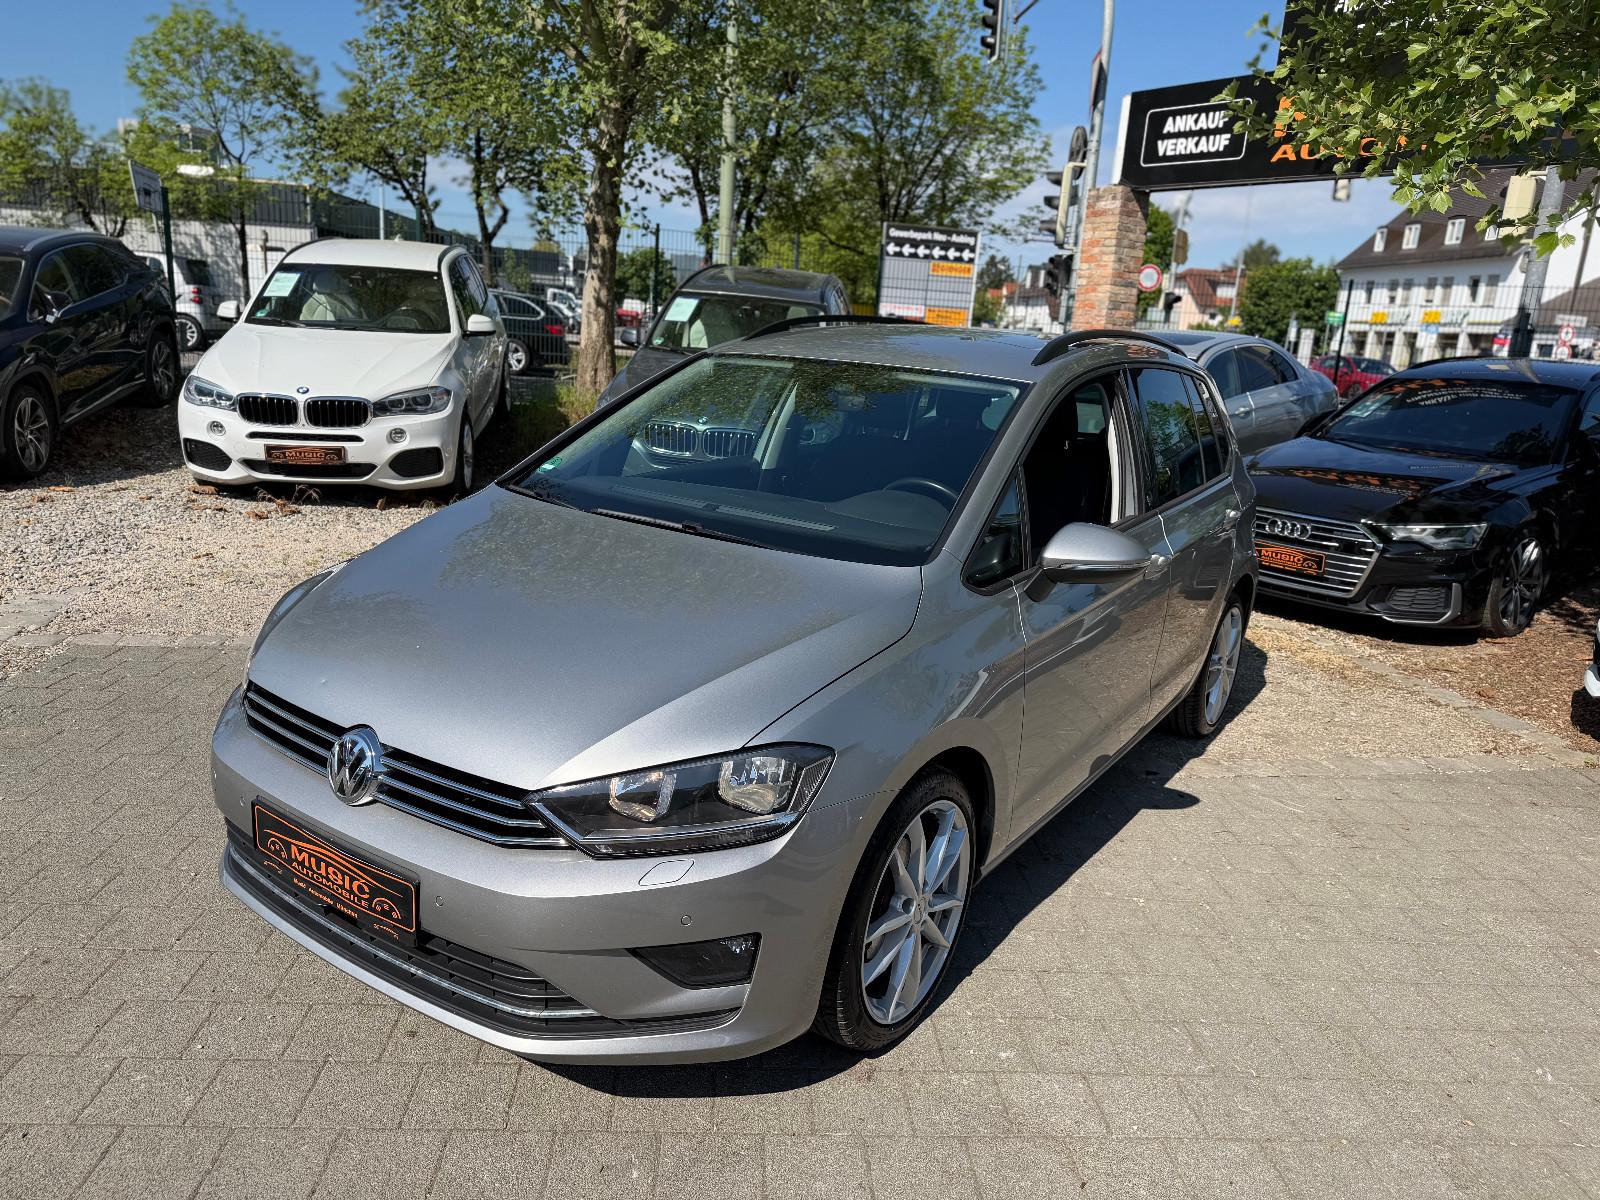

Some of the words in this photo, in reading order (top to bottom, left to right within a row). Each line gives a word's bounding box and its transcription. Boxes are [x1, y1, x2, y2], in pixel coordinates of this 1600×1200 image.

[1162, 110, 1230, 134] ANKAUF
[1157, 133, 1232, 157] VERKAUF
[291, 861, 370, 909] AUTOMOBILE
